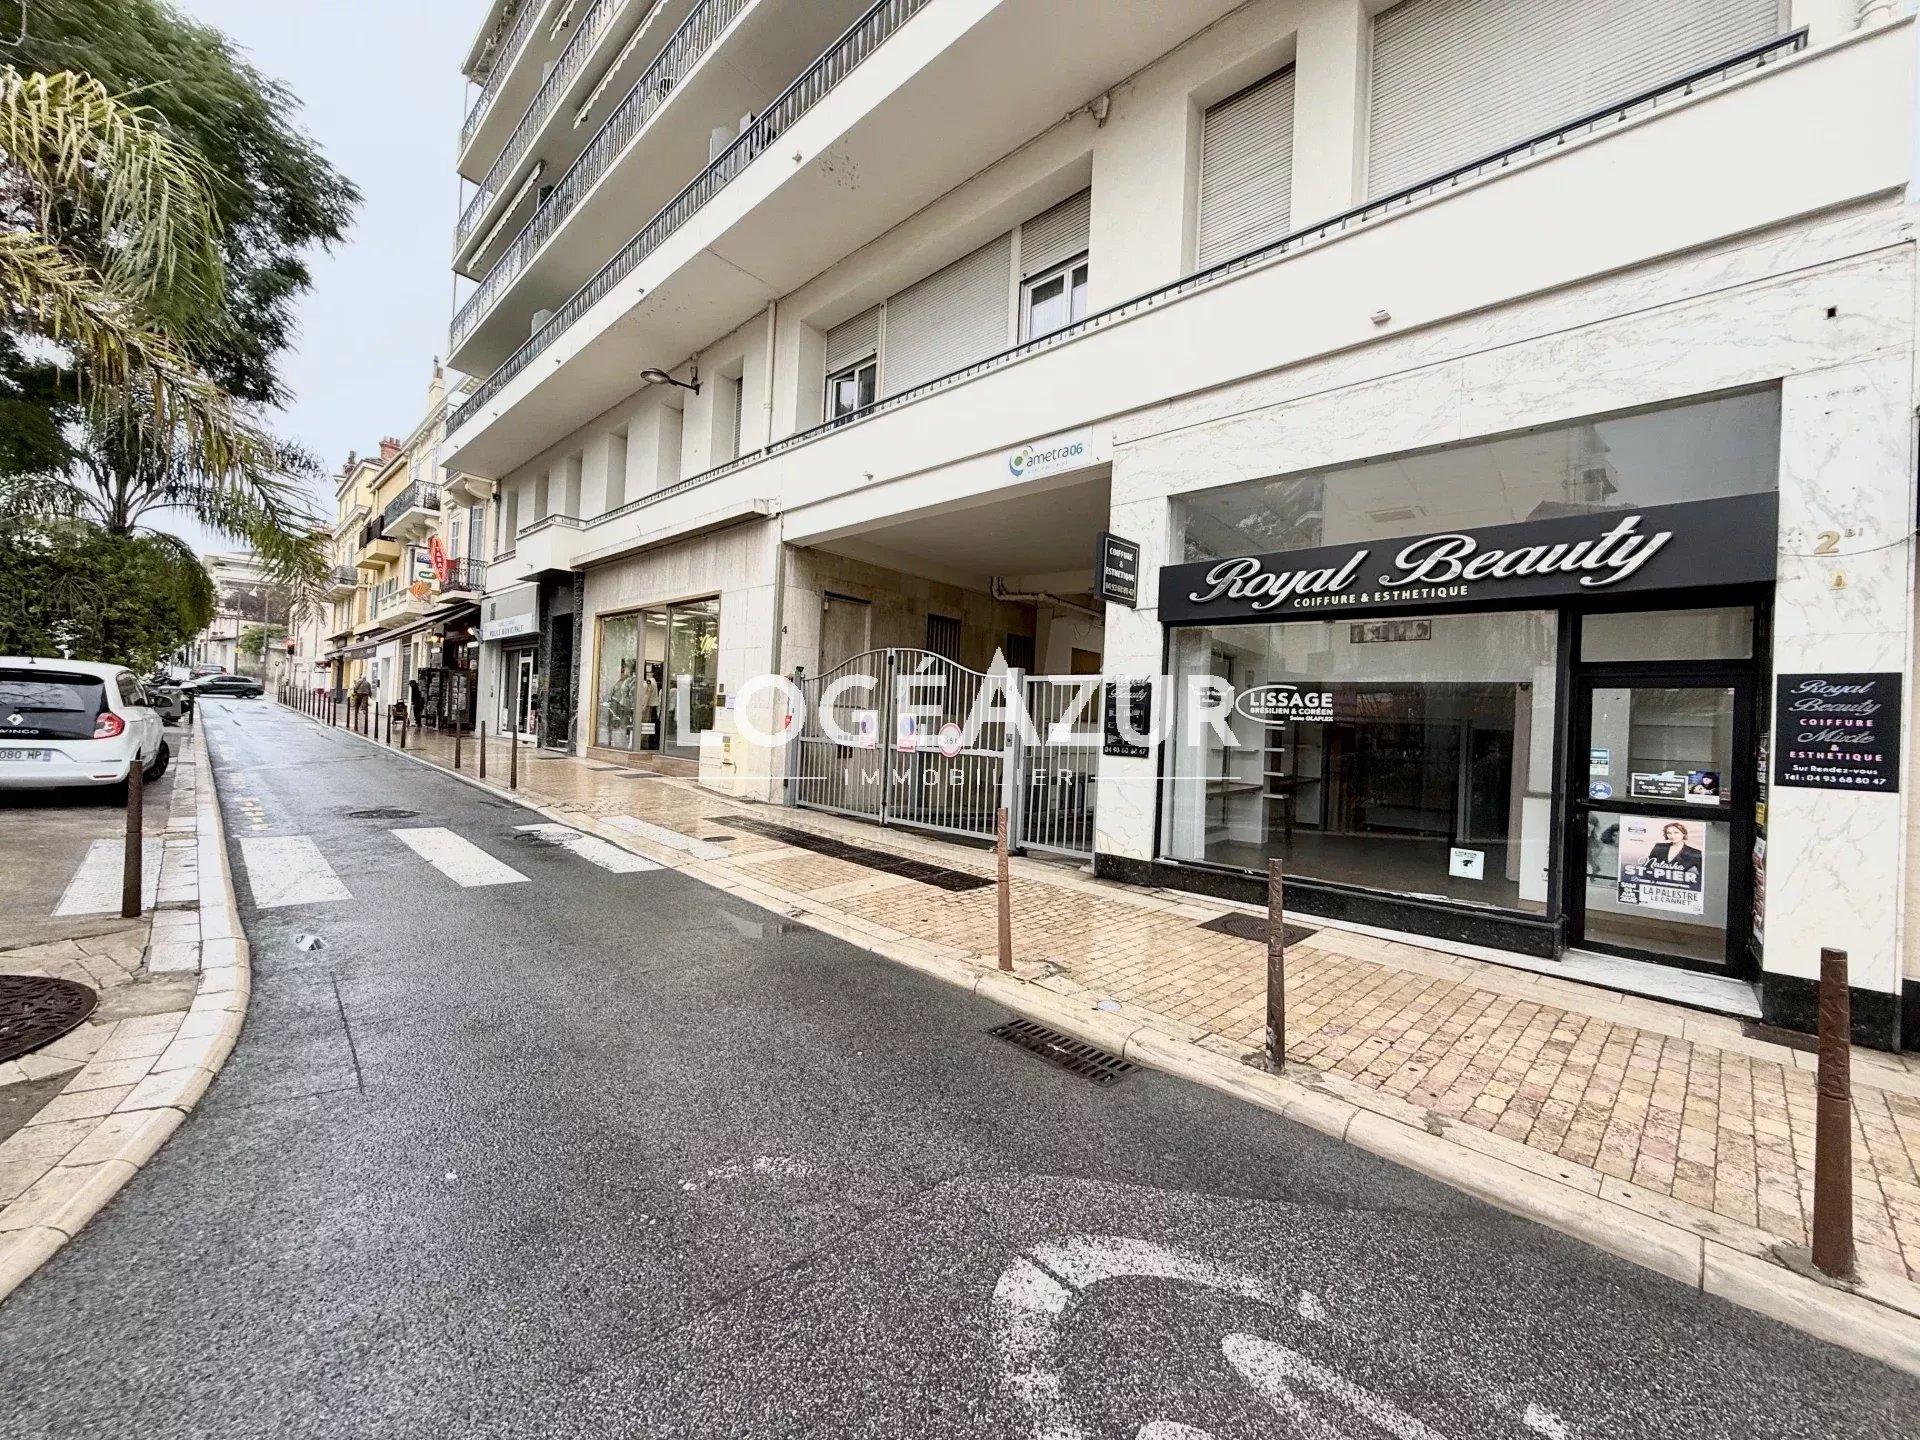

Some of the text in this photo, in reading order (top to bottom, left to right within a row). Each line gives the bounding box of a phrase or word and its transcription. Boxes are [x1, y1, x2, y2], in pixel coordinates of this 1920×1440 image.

[1026, 443, 1083, 467] ametra06
[1814, 530, 1841, 555] 2
[1109, 547, 1133, 561] COIFFURE
[1189, 515, 1673, 611] Royal Beauty
[1105, 567, 1135, 582] ESTHETIQUE
[1293, 584, 1469, 608] COIFFURE & ESTHETIQUE
[1790, 680, 1876, 697] Royal
[1249, 692, 1333, 707] LISSAGE
[1788, 697, 1882, 716] Beauty
[1250, 706, 1289, 714] BRÉSILIEN
[1298, 707, 1333, 715] CORÉEN
[1799, 718, 1873, 727] COIFFURE
[1797, 728, 1875, 743] Mixte
[1789, 751, 1883, 761] ESTHETIQUE
[1792, 764, 1878, 775] Sur Rendez-vous
[1806, 774, 1821, 782] 04
[1823, 775, 1836, 783] 93
[1638, 857, 1684, 871] Natasha
[1624, 864, 1697, 884] ST-PIER
[1643, 886, 1698, 901] LA PALESTRE
[1660, 896, 1692, 906] CANNET
